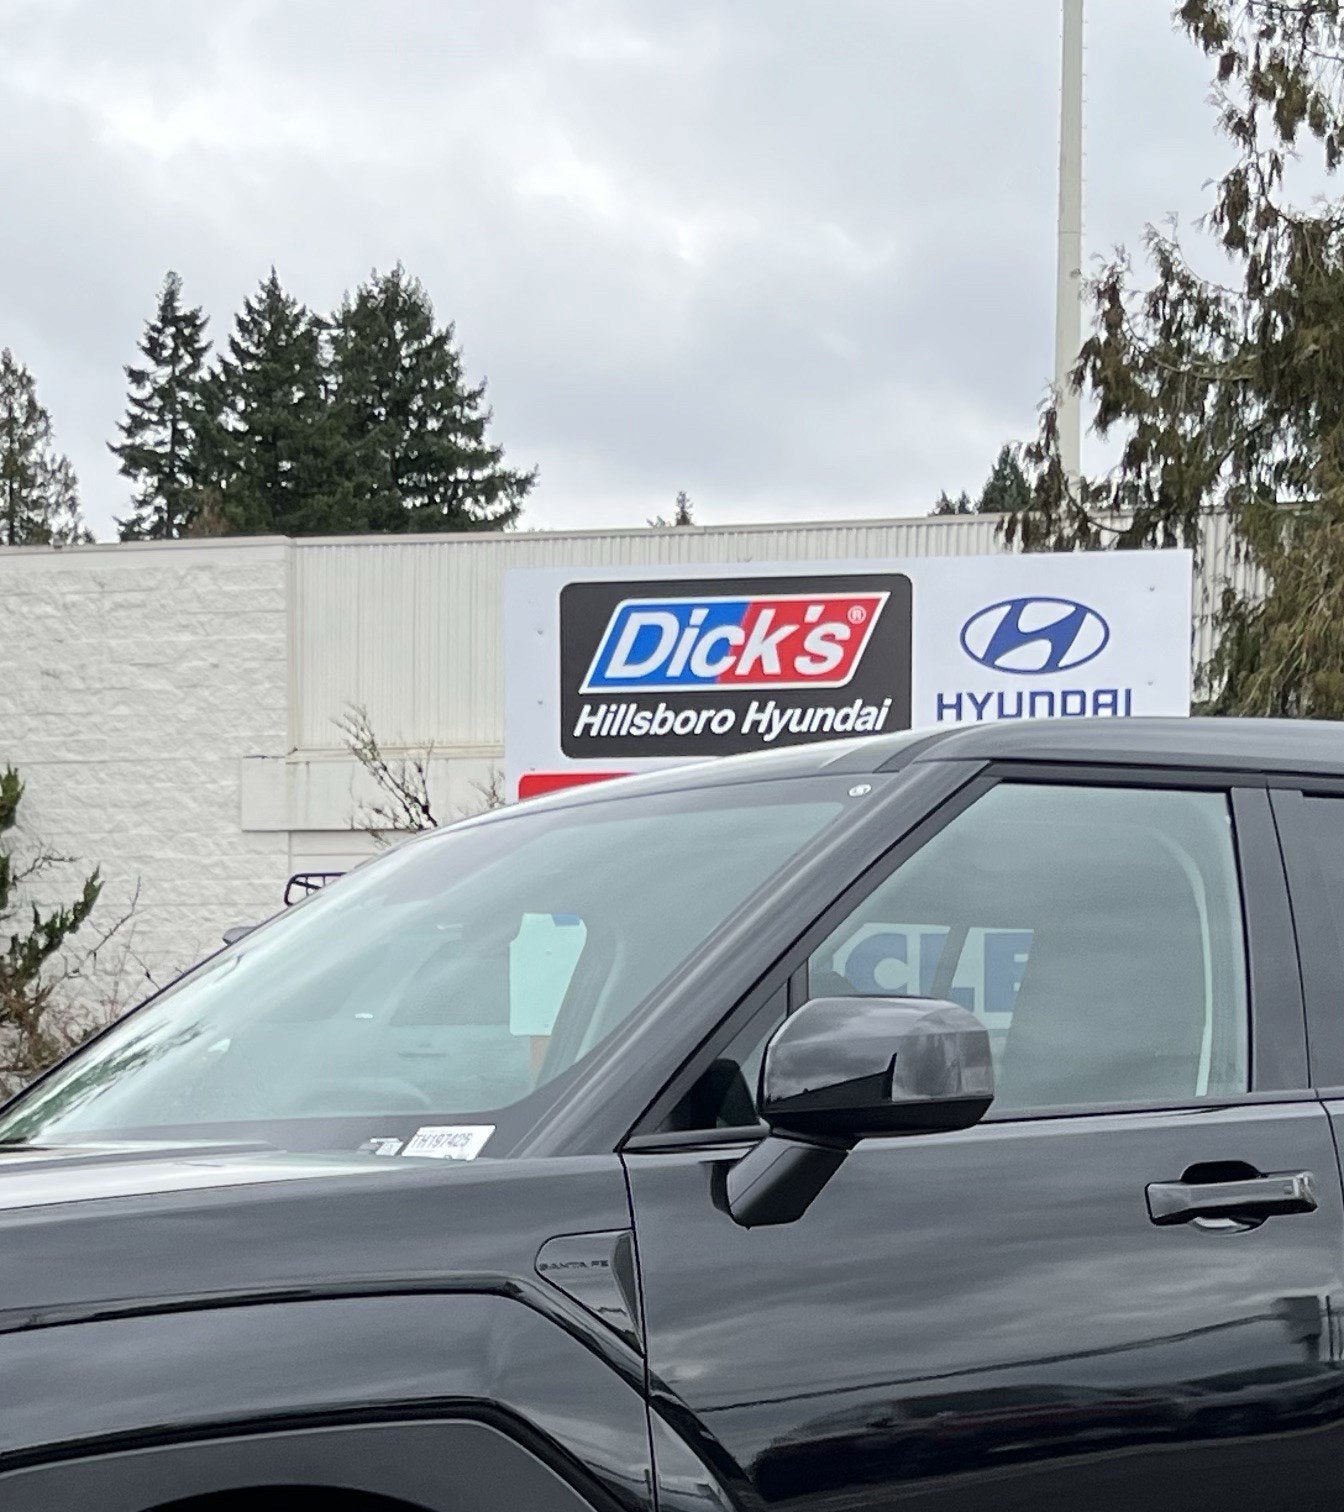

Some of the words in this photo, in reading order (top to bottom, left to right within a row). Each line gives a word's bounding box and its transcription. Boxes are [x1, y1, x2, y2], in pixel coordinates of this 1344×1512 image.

[603, 604, 852, 679] Dick's
[573, 701, 737, 738] Hillsboro
[742, 699, 892, 741] Hyundai
[936, 688, 1132, 721] HYUNDAI
